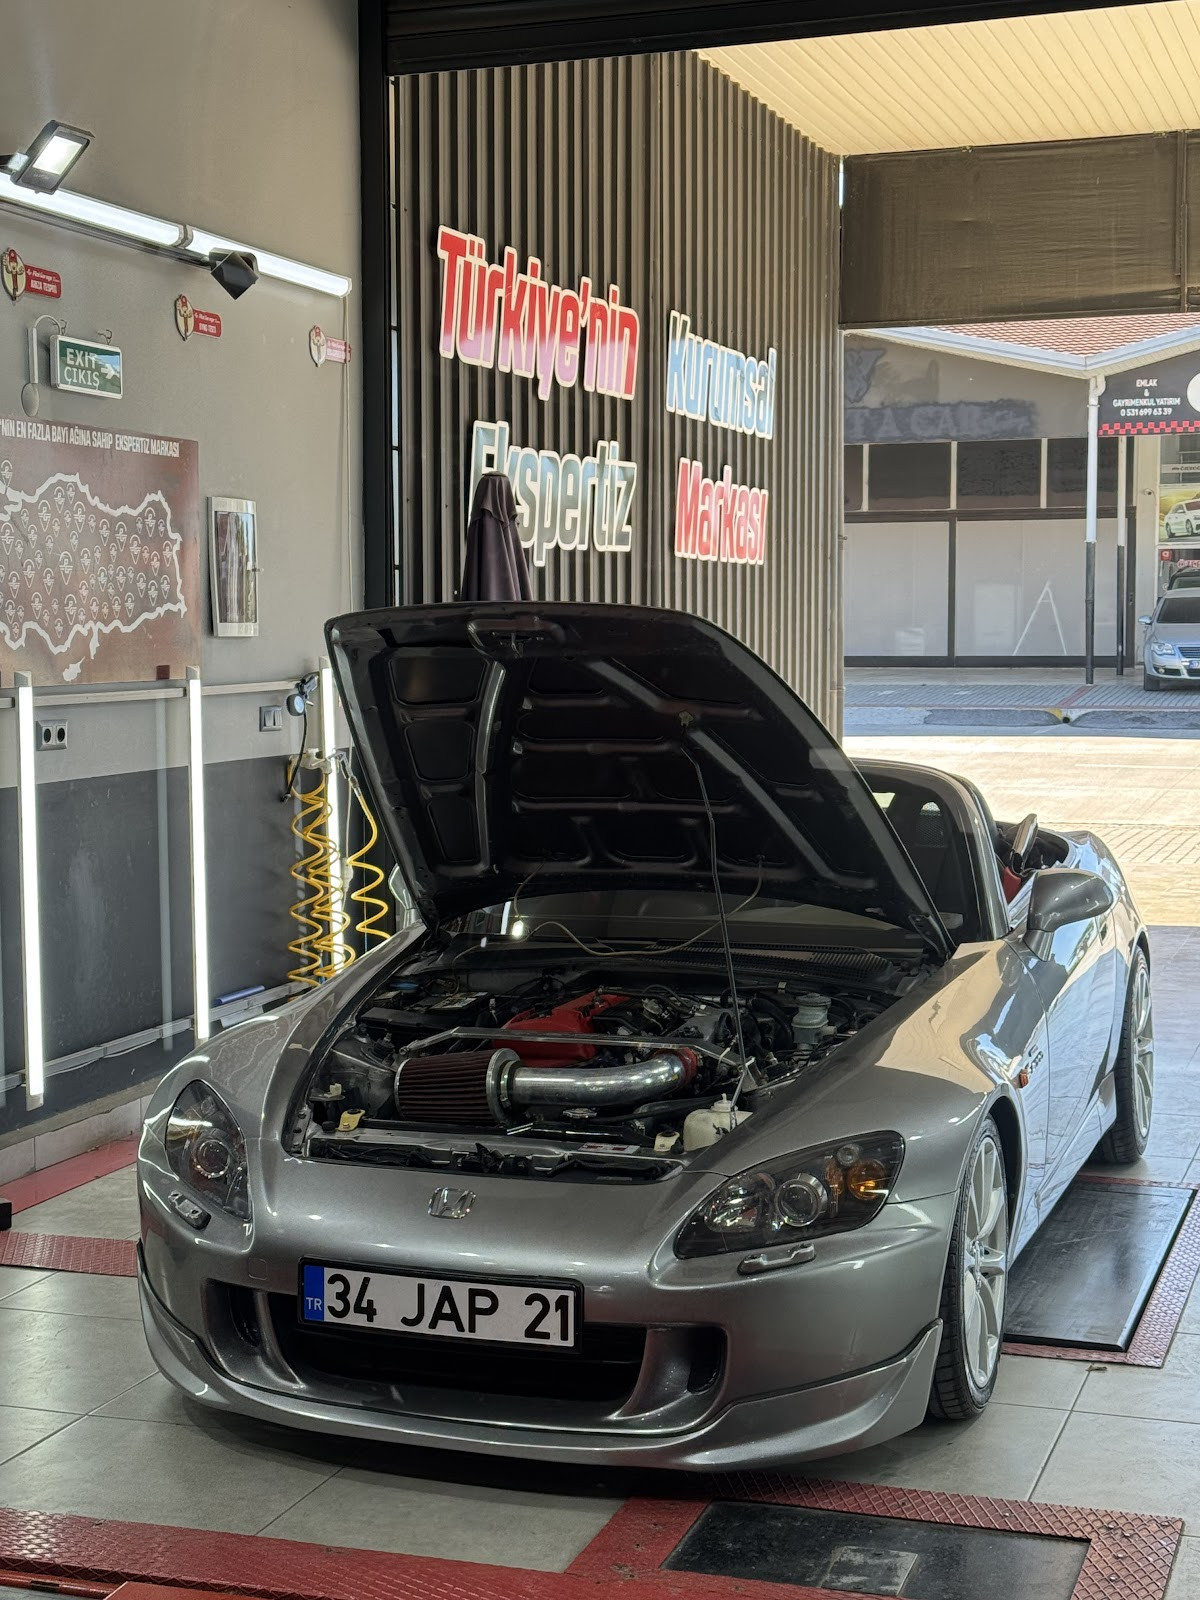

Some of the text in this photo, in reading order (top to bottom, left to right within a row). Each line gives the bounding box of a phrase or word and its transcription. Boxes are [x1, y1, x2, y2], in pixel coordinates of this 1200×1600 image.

[438, 225, 640, 401] Türkiye'nin
[66, 347, 96, 370] EXIT
[64, 366, 100, 391] ÇIKIŞ
[666, 310, 777, 440] Kurumsal
[1136, 379, 1158, 387] EMLAK
[1126, 408, 1138, 417] 531
[1139, 408, 1152, 417] 699
[1163, 407, 1173, 416] 39
[1155, 397, 1181, 406] YATIRIM
[16, 420, 26, 439] EN
[27, 422, 51, 442] FAZLA
[69, 425, 91, 447] AĞINA
[92, 430, 113, 449] SAHİP
[150, 438, 180, 458] MARKASI
[674, 457, 768, 565] Markası
[306, 1297, 322, 1310] TR
[327, 1273, 570, 1342] 34 JAP 21
